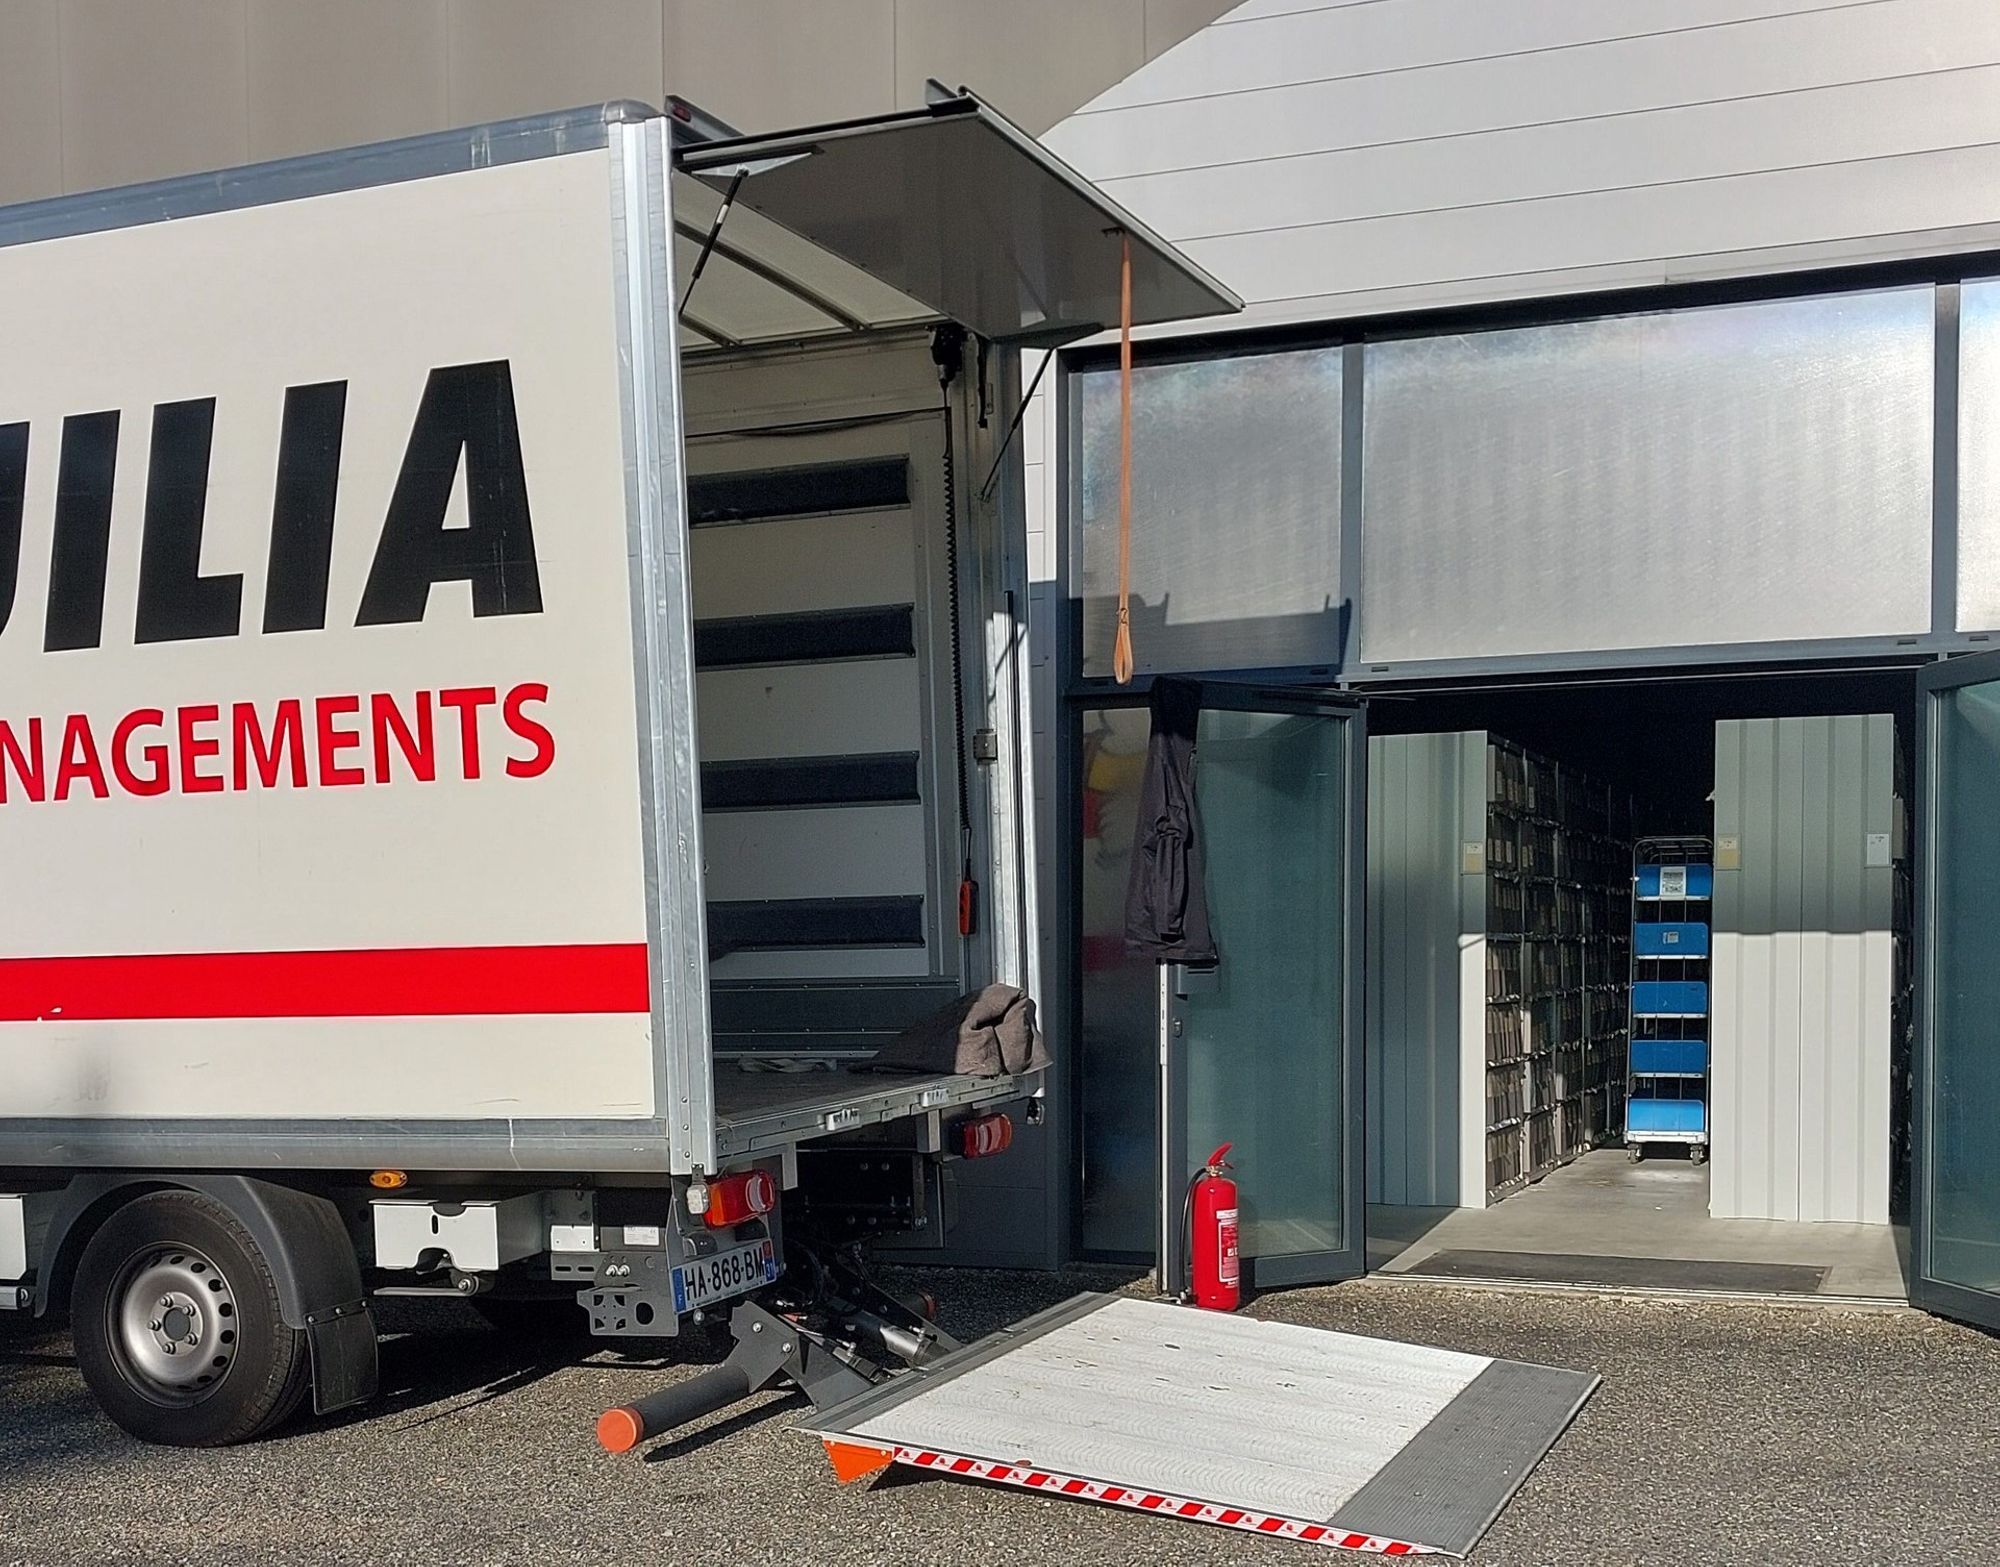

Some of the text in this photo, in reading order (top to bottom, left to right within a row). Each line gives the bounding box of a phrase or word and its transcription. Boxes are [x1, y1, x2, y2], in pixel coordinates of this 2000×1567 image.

[0, 359, 543, 653] ILIA
[0, 684, 555, 804] NAGEMENTS
[684, 1247, 764, 1301] HA-868-BM
